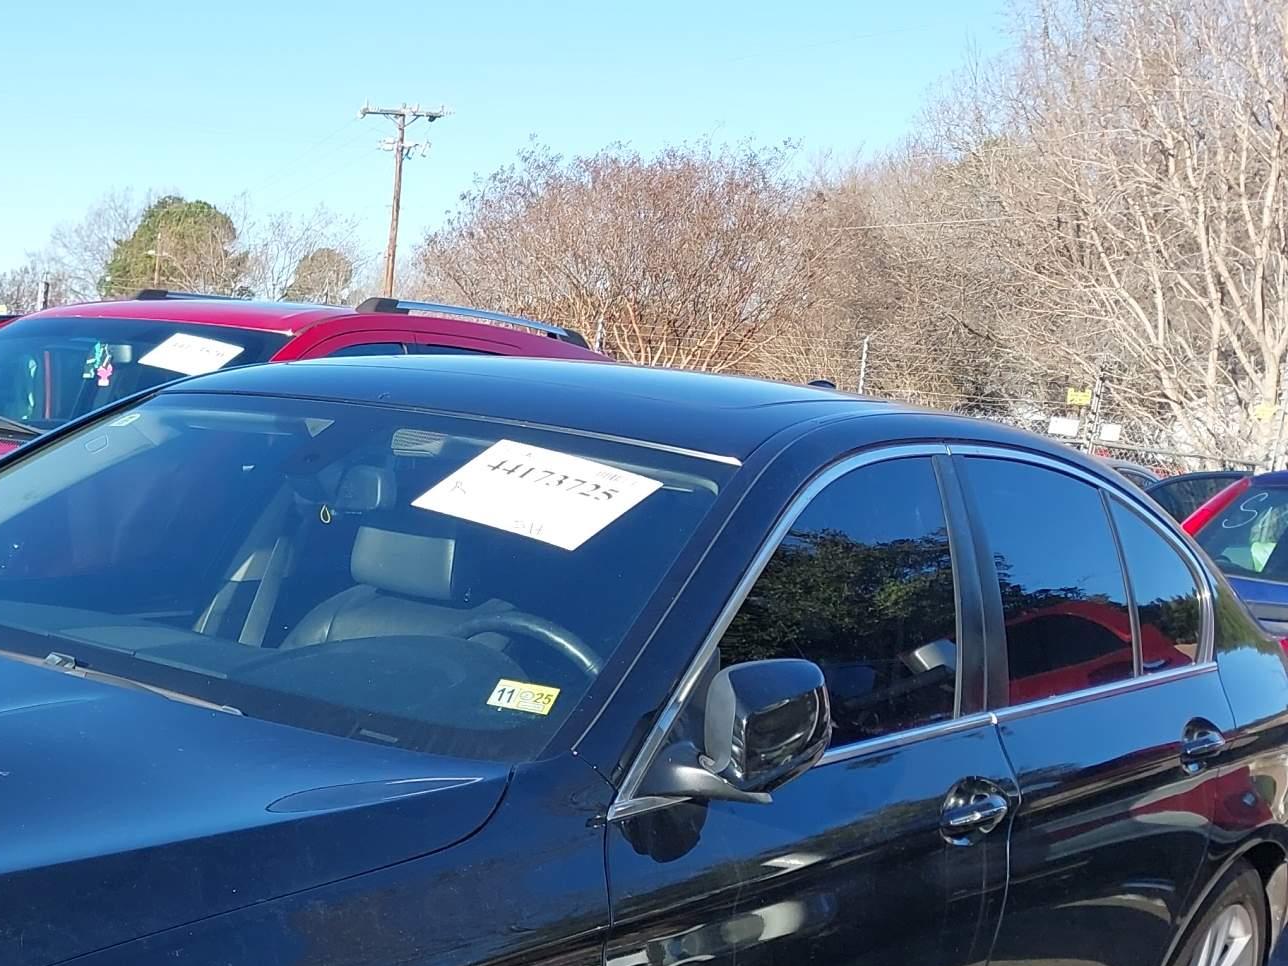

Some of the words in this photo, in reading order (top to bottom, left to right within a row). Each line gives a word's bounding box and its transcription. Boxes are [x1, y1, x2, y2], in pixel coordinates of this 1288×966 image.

[487, 460, 620, 500] 44173725
[497, 687, 516, 703] 11
[533, 692, 554, 705] 25
